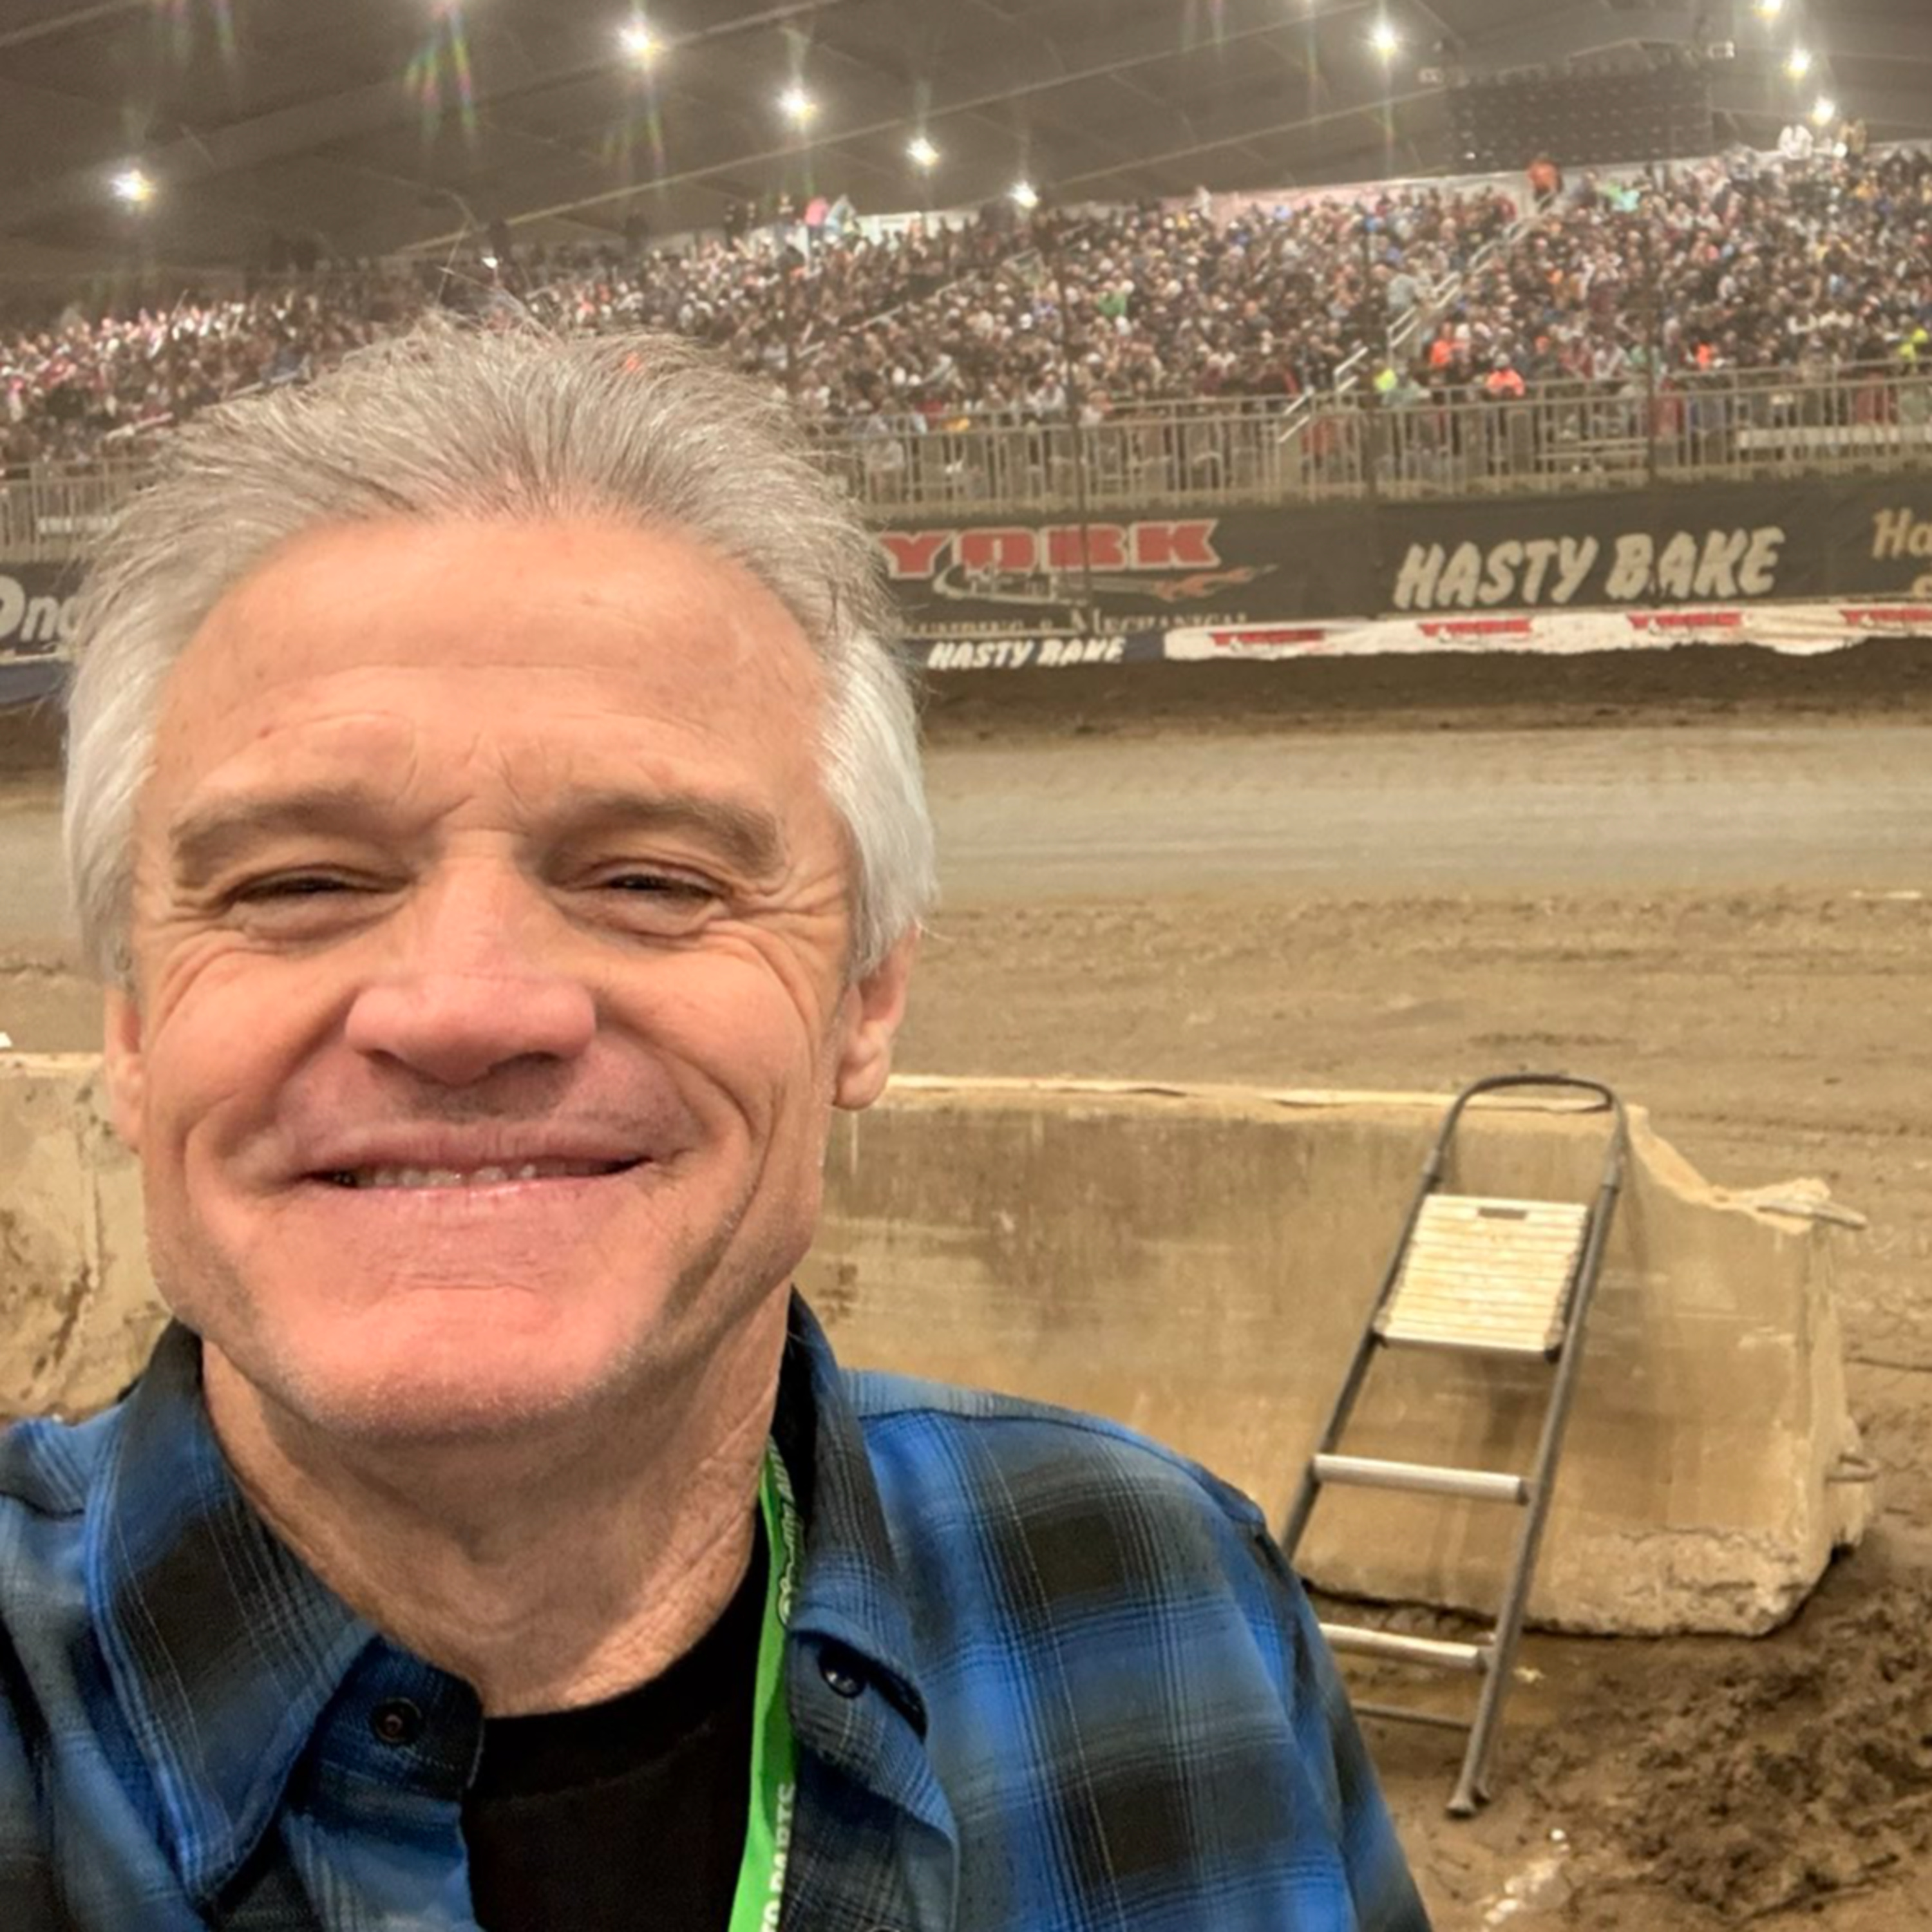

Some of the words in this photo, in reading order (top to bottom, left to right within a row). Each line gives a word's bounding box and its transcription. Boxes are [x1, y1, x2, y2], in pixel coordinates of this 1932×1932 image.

[871, 519, 1222, 580] YORK
[1393, 535, 1598, 610] HASTY
[1605, 526, 1786, 600] BAKE
[927, 639, 1034, 669] HASTY
[1036, 635, 1126, 666] BAKE
